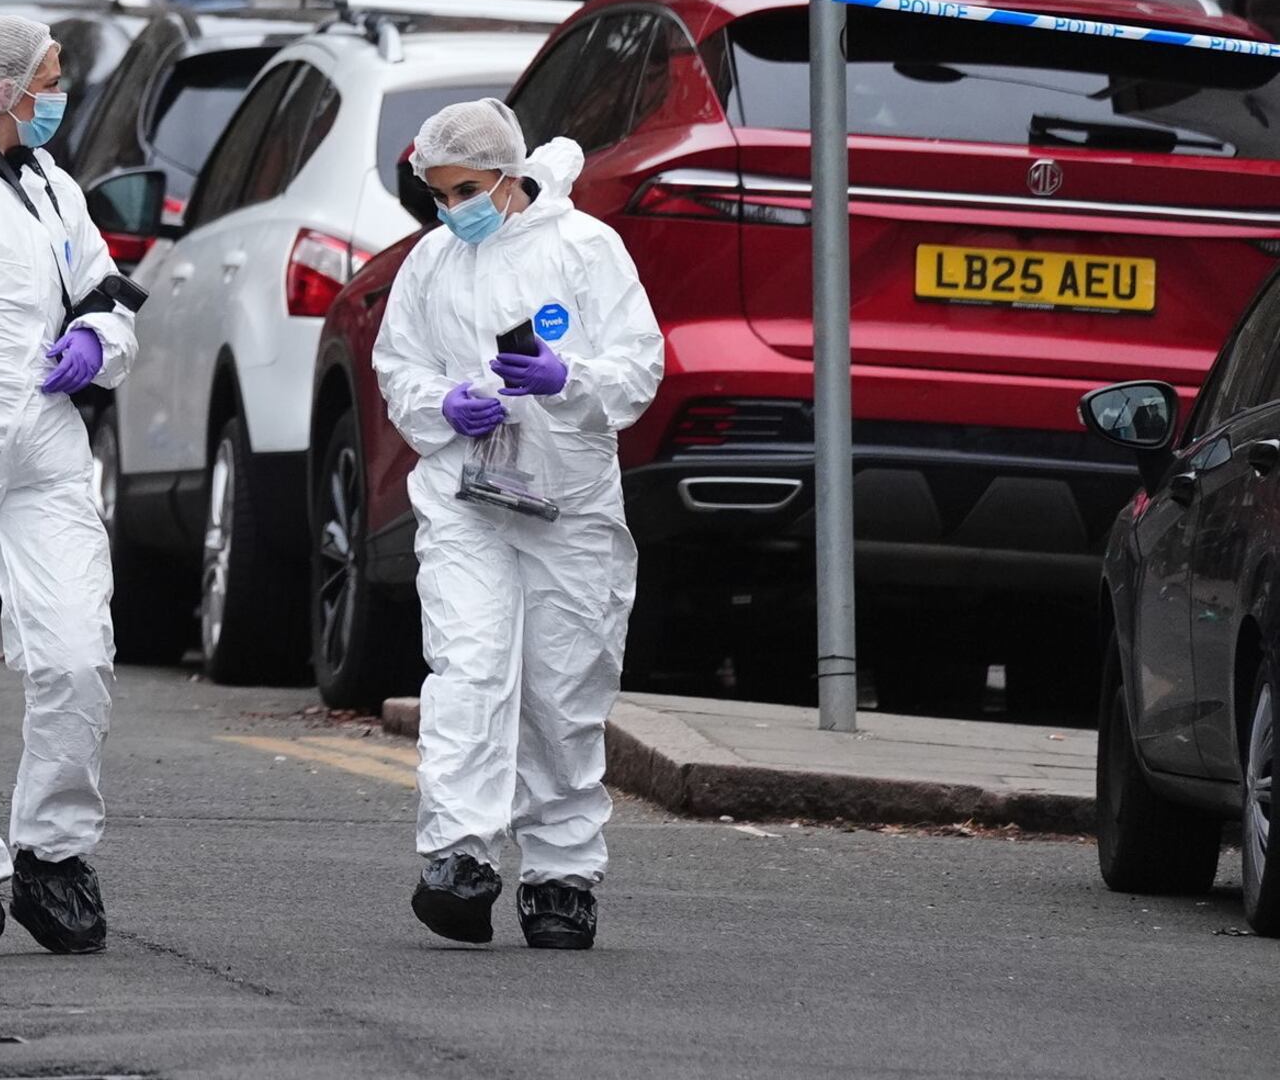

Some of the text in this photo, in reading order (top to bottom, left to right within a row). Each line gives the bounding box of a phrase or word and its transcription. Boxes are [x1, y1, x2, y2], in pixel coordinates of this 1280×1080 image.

[935, 251, 1138, 301] LB25 AEU
[540, 316, 564, 329] Tyvek
